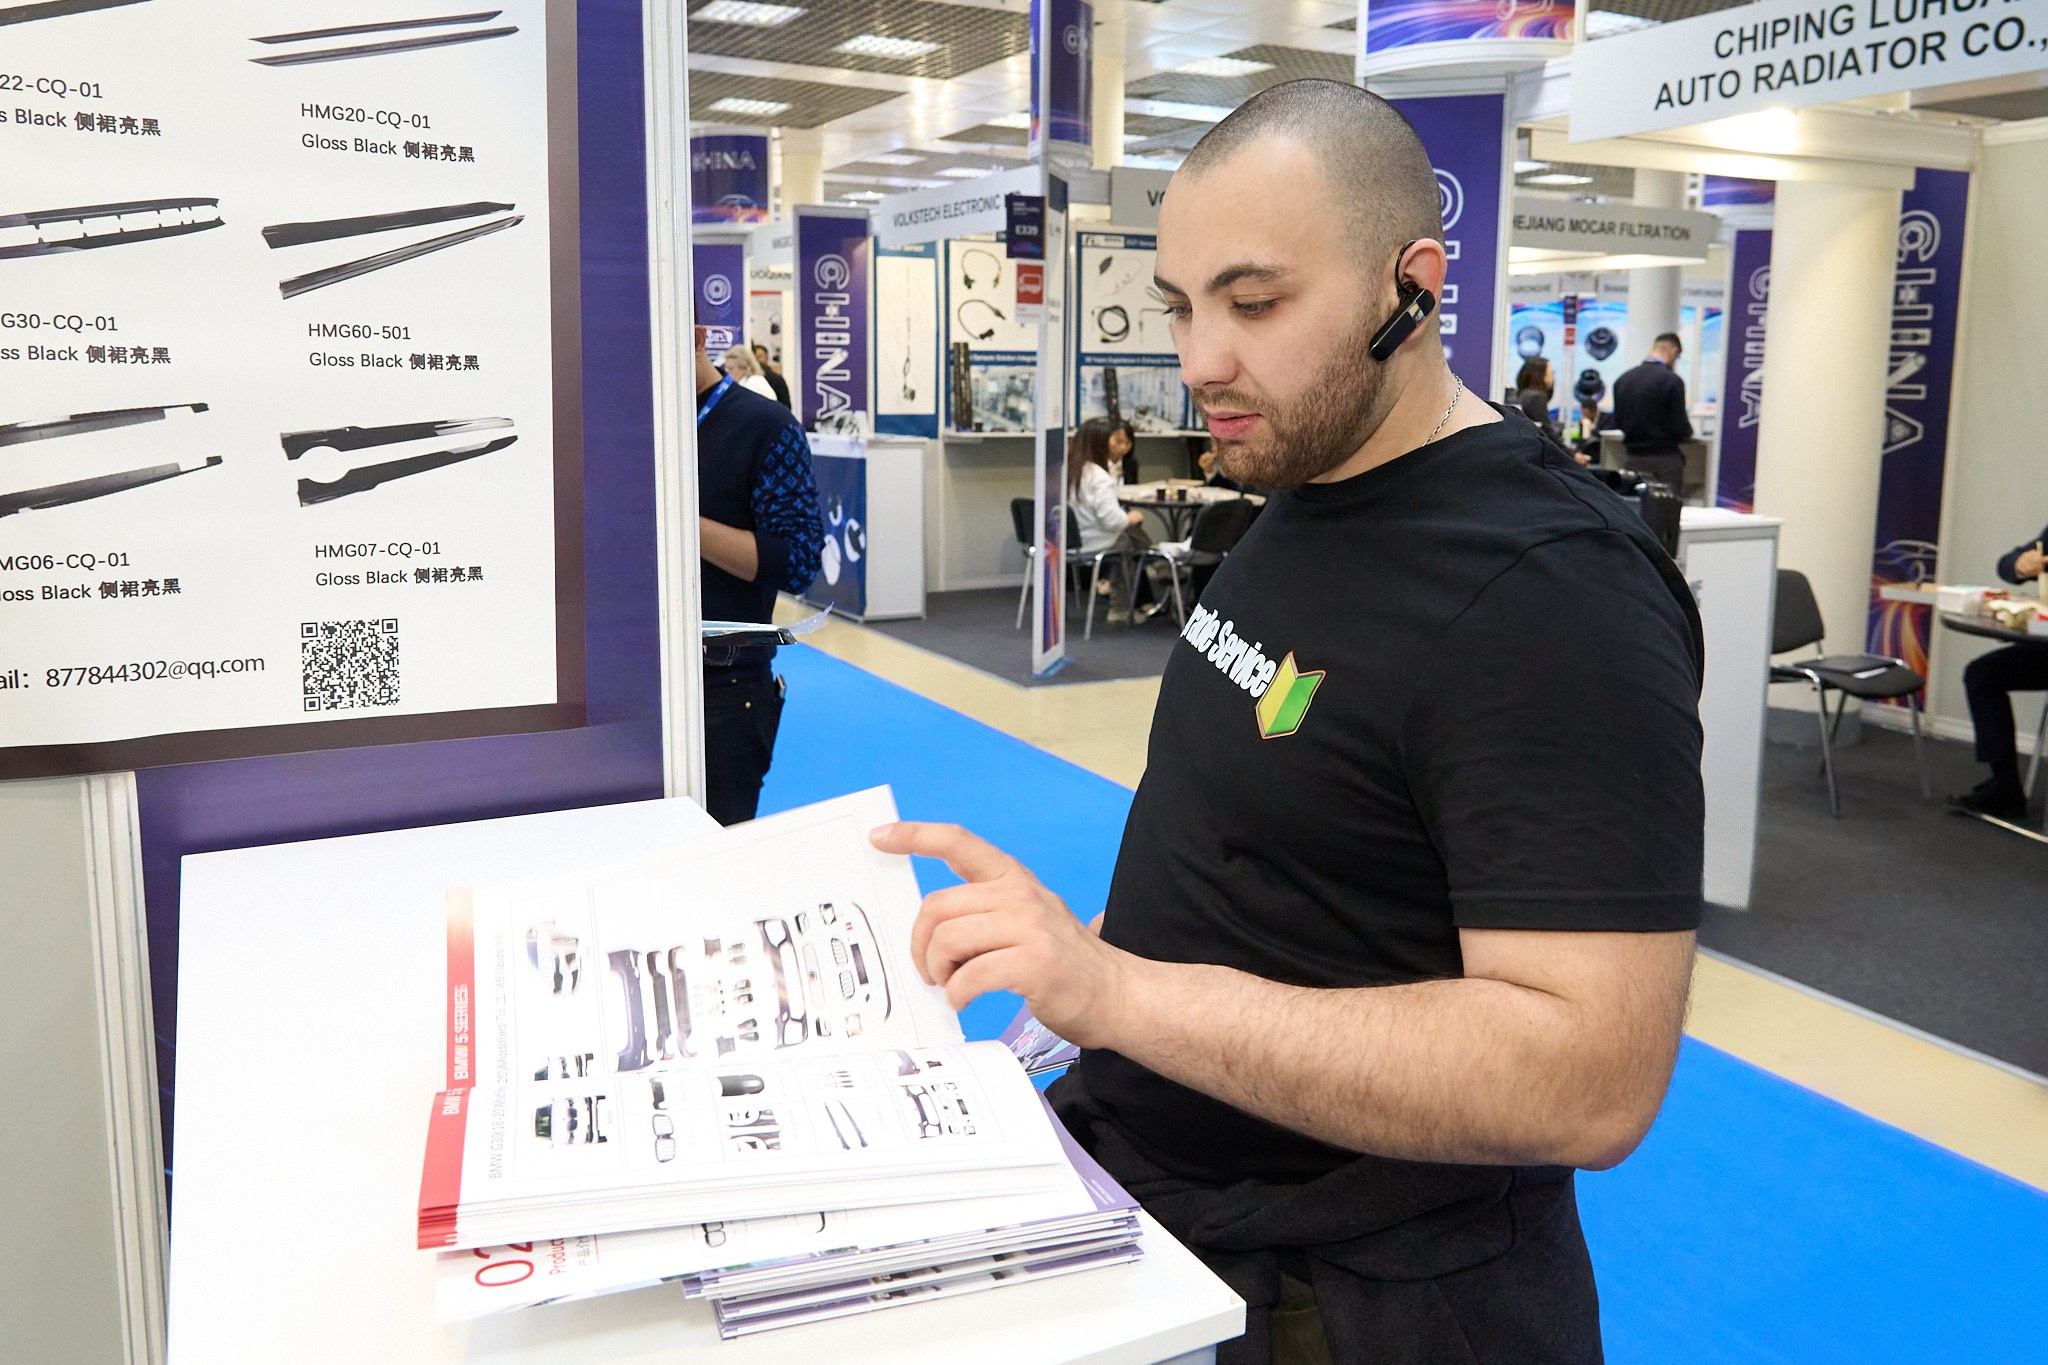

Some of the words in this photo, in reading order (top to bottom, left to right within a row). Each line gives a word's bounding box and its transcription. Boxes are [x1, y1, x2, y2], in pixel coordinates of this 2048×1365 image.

[1714, 5, 1854, 59] CHIPING
[1654, 70, 1740, 111] AUTO
[1753, 31, 1946, 94] RADIATOR
[1963, 16, 2048, 57] CO.,
[16, 109, 67, 128] Black
[74, 112, 161, 137] 侧裙亮黑
[301, 103, 431, 130] HMG20-CQ-01
[301, 133, 348, 151] Gloss
[354, 137, 397, 156] Black
[403, 141, 475, 163] 侧裙亮黑
[893, 206, 942, 228] VOLKSTECH
[943, 194, 1001, 219] ELECTRONIC
[1568, 218, 1616, 235] MOCAR
[1619, 222, 1690, 241] FILTRATION
[1, 312, 118, 333] G30-CQ-01
[308, 323, 411, 340] HMG60-501
[814, 254, 852, 420] CHINA
[28, 345, 79, 361] Black
[86, 345, 171, 364] 侧裙亮黑
[309, 352, 355, 367] Gloss
[361, 353, 403, 368] Black
[409, 353, 480, 370] 侧裙亮黑
[315, 541, 441, 559] HMG07-CQ-01
[41, 583, 92, 600] Black
[98, 578, 181, 600] 侧裙亮黑
[315, 572, 360, 586] Gloss
[366, 569, 408, 584] Black
[413, 566, 484, 584] 侧裙亮黑
[1180, 603, 1221, 653] rade
[1207, 620, 1277, 698] Service
[46, 657, 265, 689] 877844302@qq.com
[453, 983, 469, 1034] SERIES
[453, 1033, 469, 1045] 5
[453, 1045, 469, 1081] BMW
[442, 1095, 461, 1116] BMW
[489, 1153, 504, 1179] BMW
